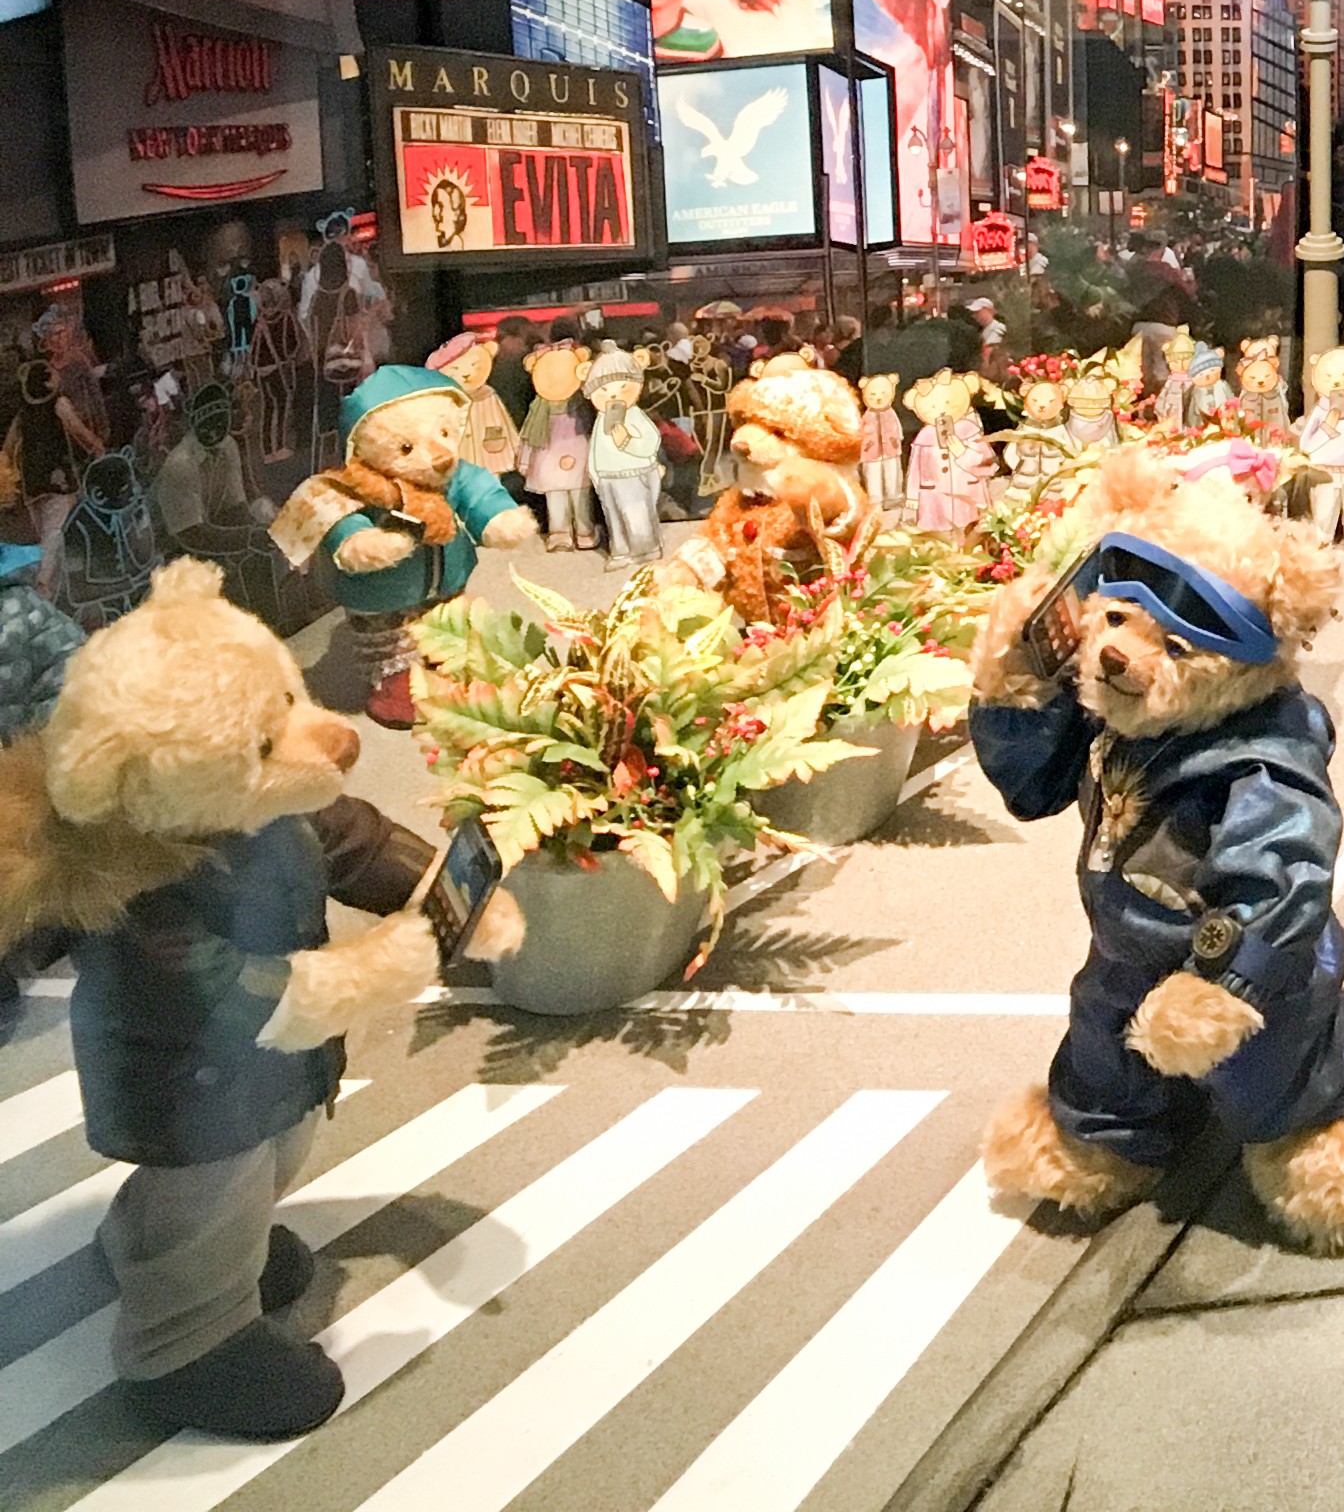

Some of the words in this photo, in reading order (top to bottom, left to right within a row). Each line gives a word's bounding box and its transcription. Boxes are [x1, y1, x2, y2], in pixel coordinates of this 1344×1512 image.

[388, 59, 629, 109] MARQUIS
[501, 151, 627, 247] EVITA
[672, 205, 748, 222] AMERICAN
[752, 201, 798, 215] EAGLE
